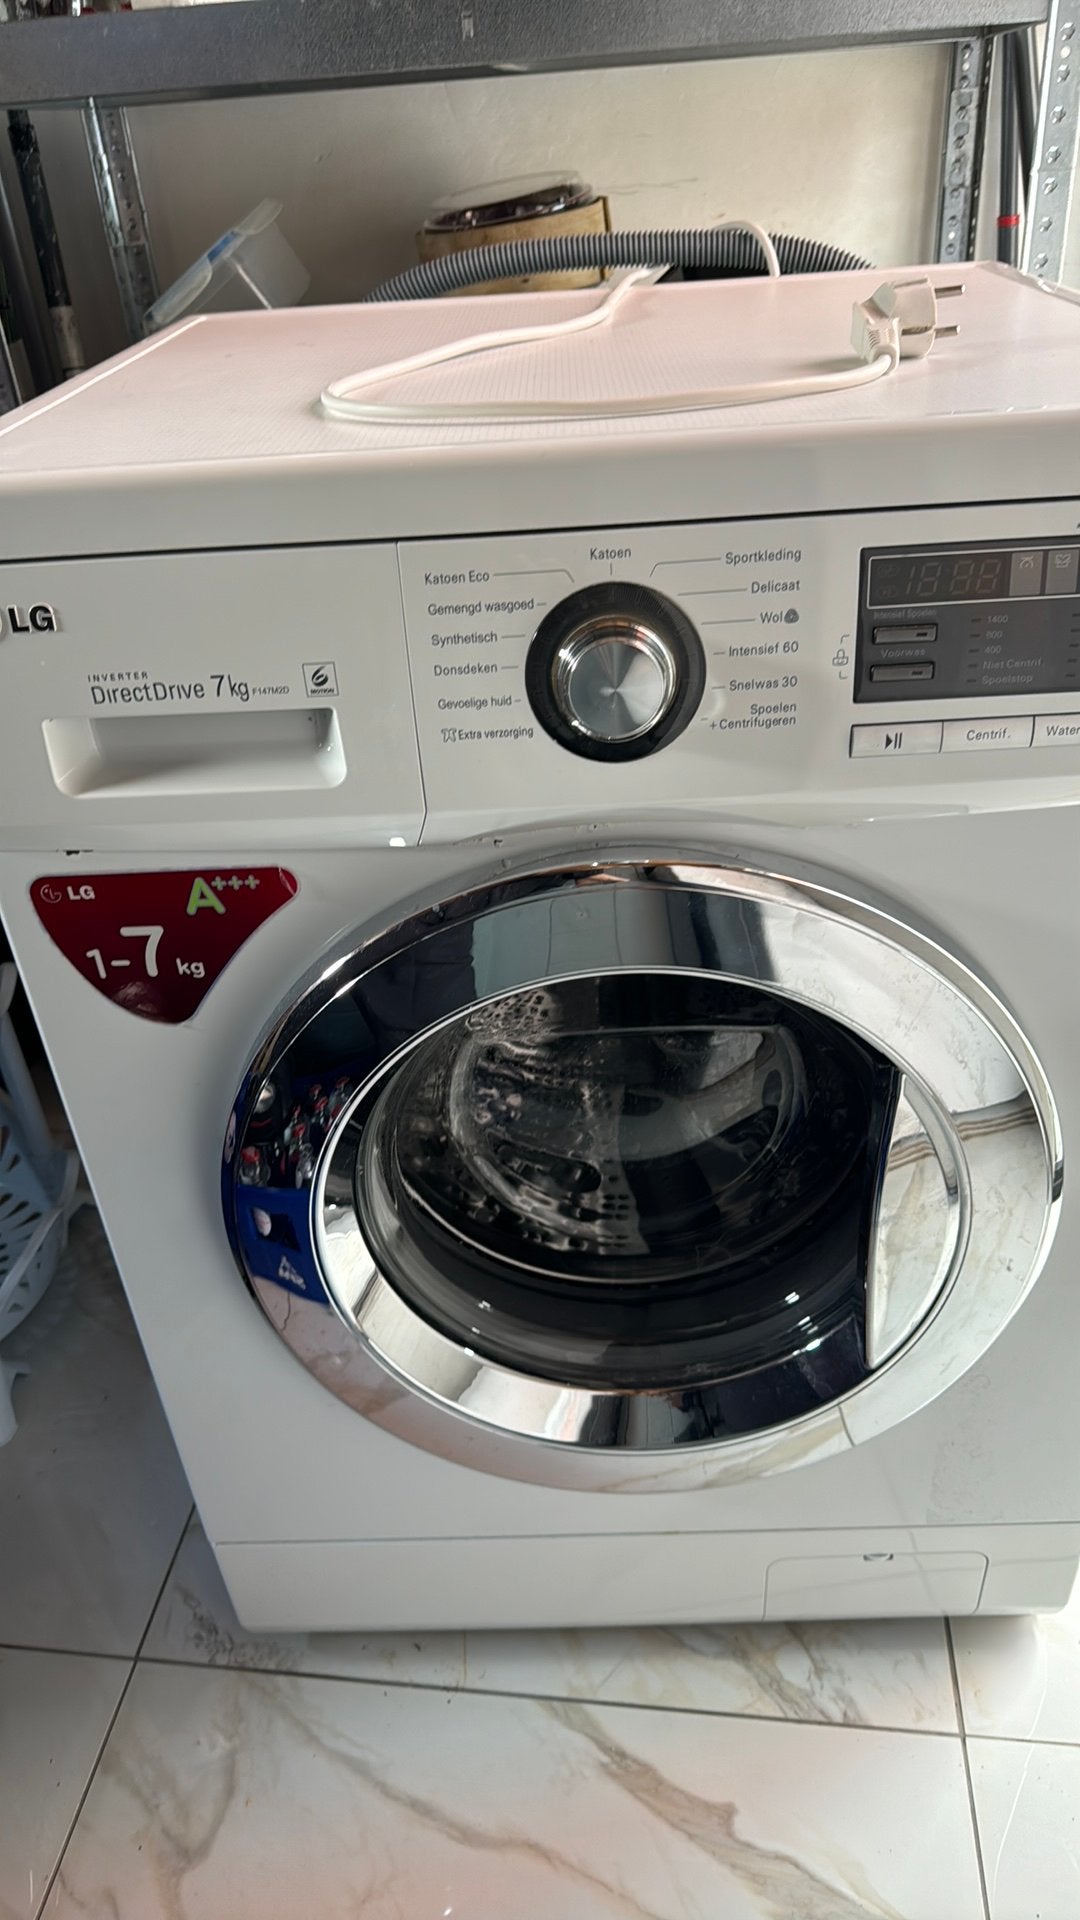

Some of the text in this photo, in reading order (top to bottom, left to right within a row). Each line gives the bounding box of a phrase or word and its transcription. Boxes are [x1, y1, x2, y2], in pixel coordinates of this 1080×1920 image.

[590, 546, 632, 561] Katoen
[725, 548, 802, 566] Sportkleding
[424, 570, 490, 585] Katoen Eco
[751, 580, 801, 594] Delicaat
[427, 597, 535, 616] Gemengd wasgoed
[8, 605, 56, 633] LG
[760, 611, 783, 624] Wol
[431, 631, 498, 648] Synthetisch
[729, 641, 799, 657] Intensief 60
[433, 661, 498, 676] Donsdeken
[87, 671, 149, 682] INVERTER
[729, 675, 798, 692] Snelwas 30
[437, 695, 513, 711] Gevoelige huid
[750, 702, 797, 717] Spoelen
[457, 726, 534, 741] Extra verzorging
[966, 727, 1011, 741] Centrif.
[67, 886, 96, 900] LG
[176, 957, 206, 978] kg
